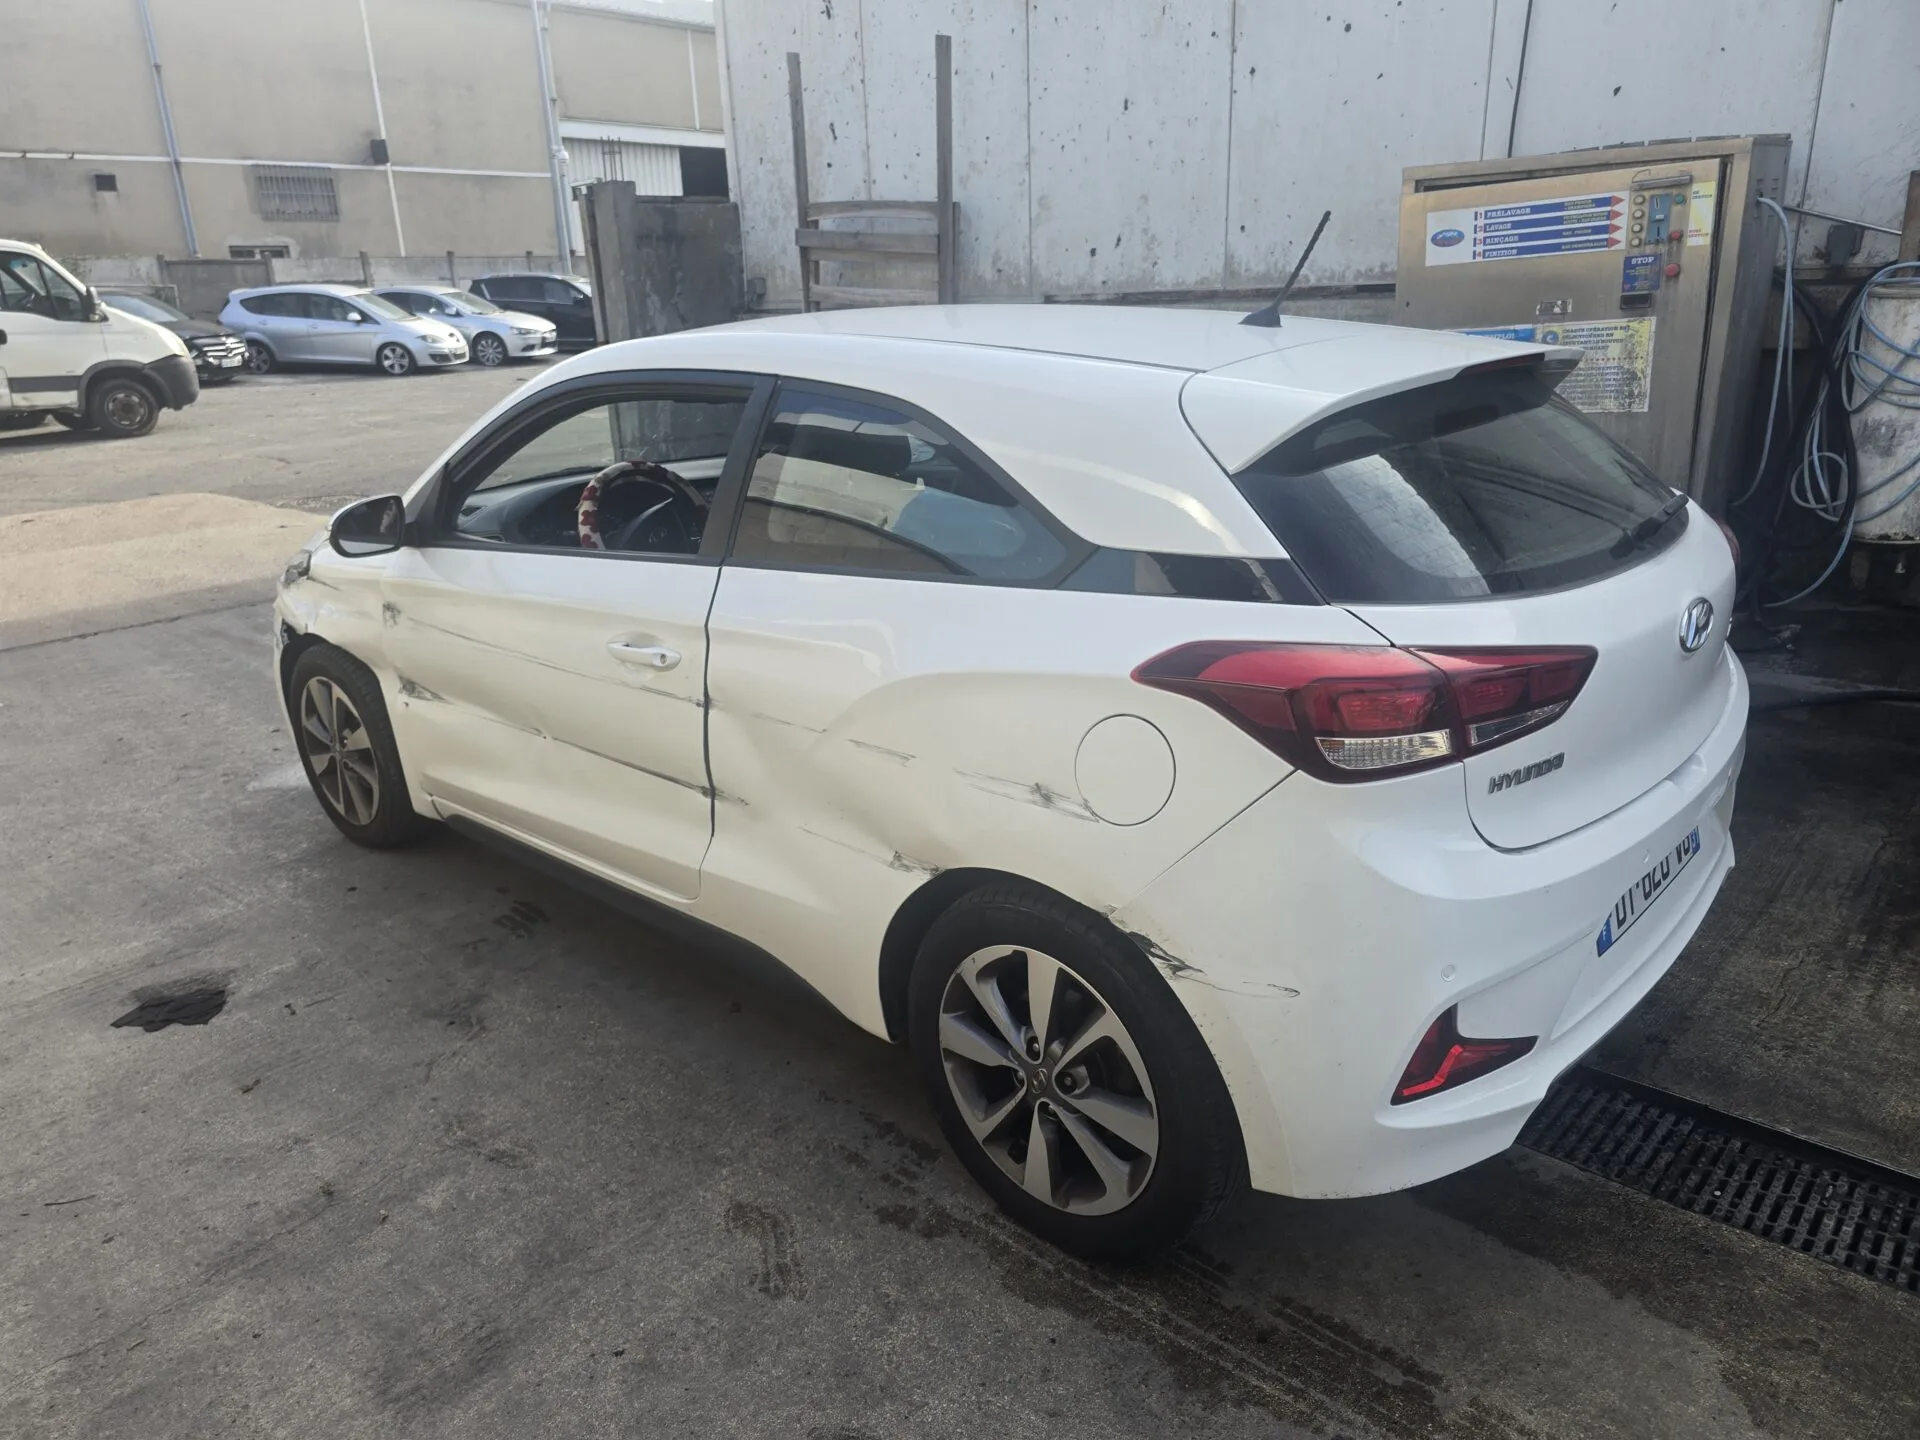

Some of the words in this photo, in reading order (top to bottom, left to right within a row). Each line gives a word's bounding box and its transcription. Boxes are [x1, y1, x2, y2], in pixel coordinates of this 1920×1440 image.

[1486, 207, 1531, 218] PRÉLAVAGE
[1486, 223, 1512, 231] LAVAGE
[1485, 236, 1519, 244] RINÇAGE
[1484, 249, 1518, 258] FINITION
[1631, 256, 1655, 265] STOP
[1488, 752, 1565, 795] HYUNDAI
